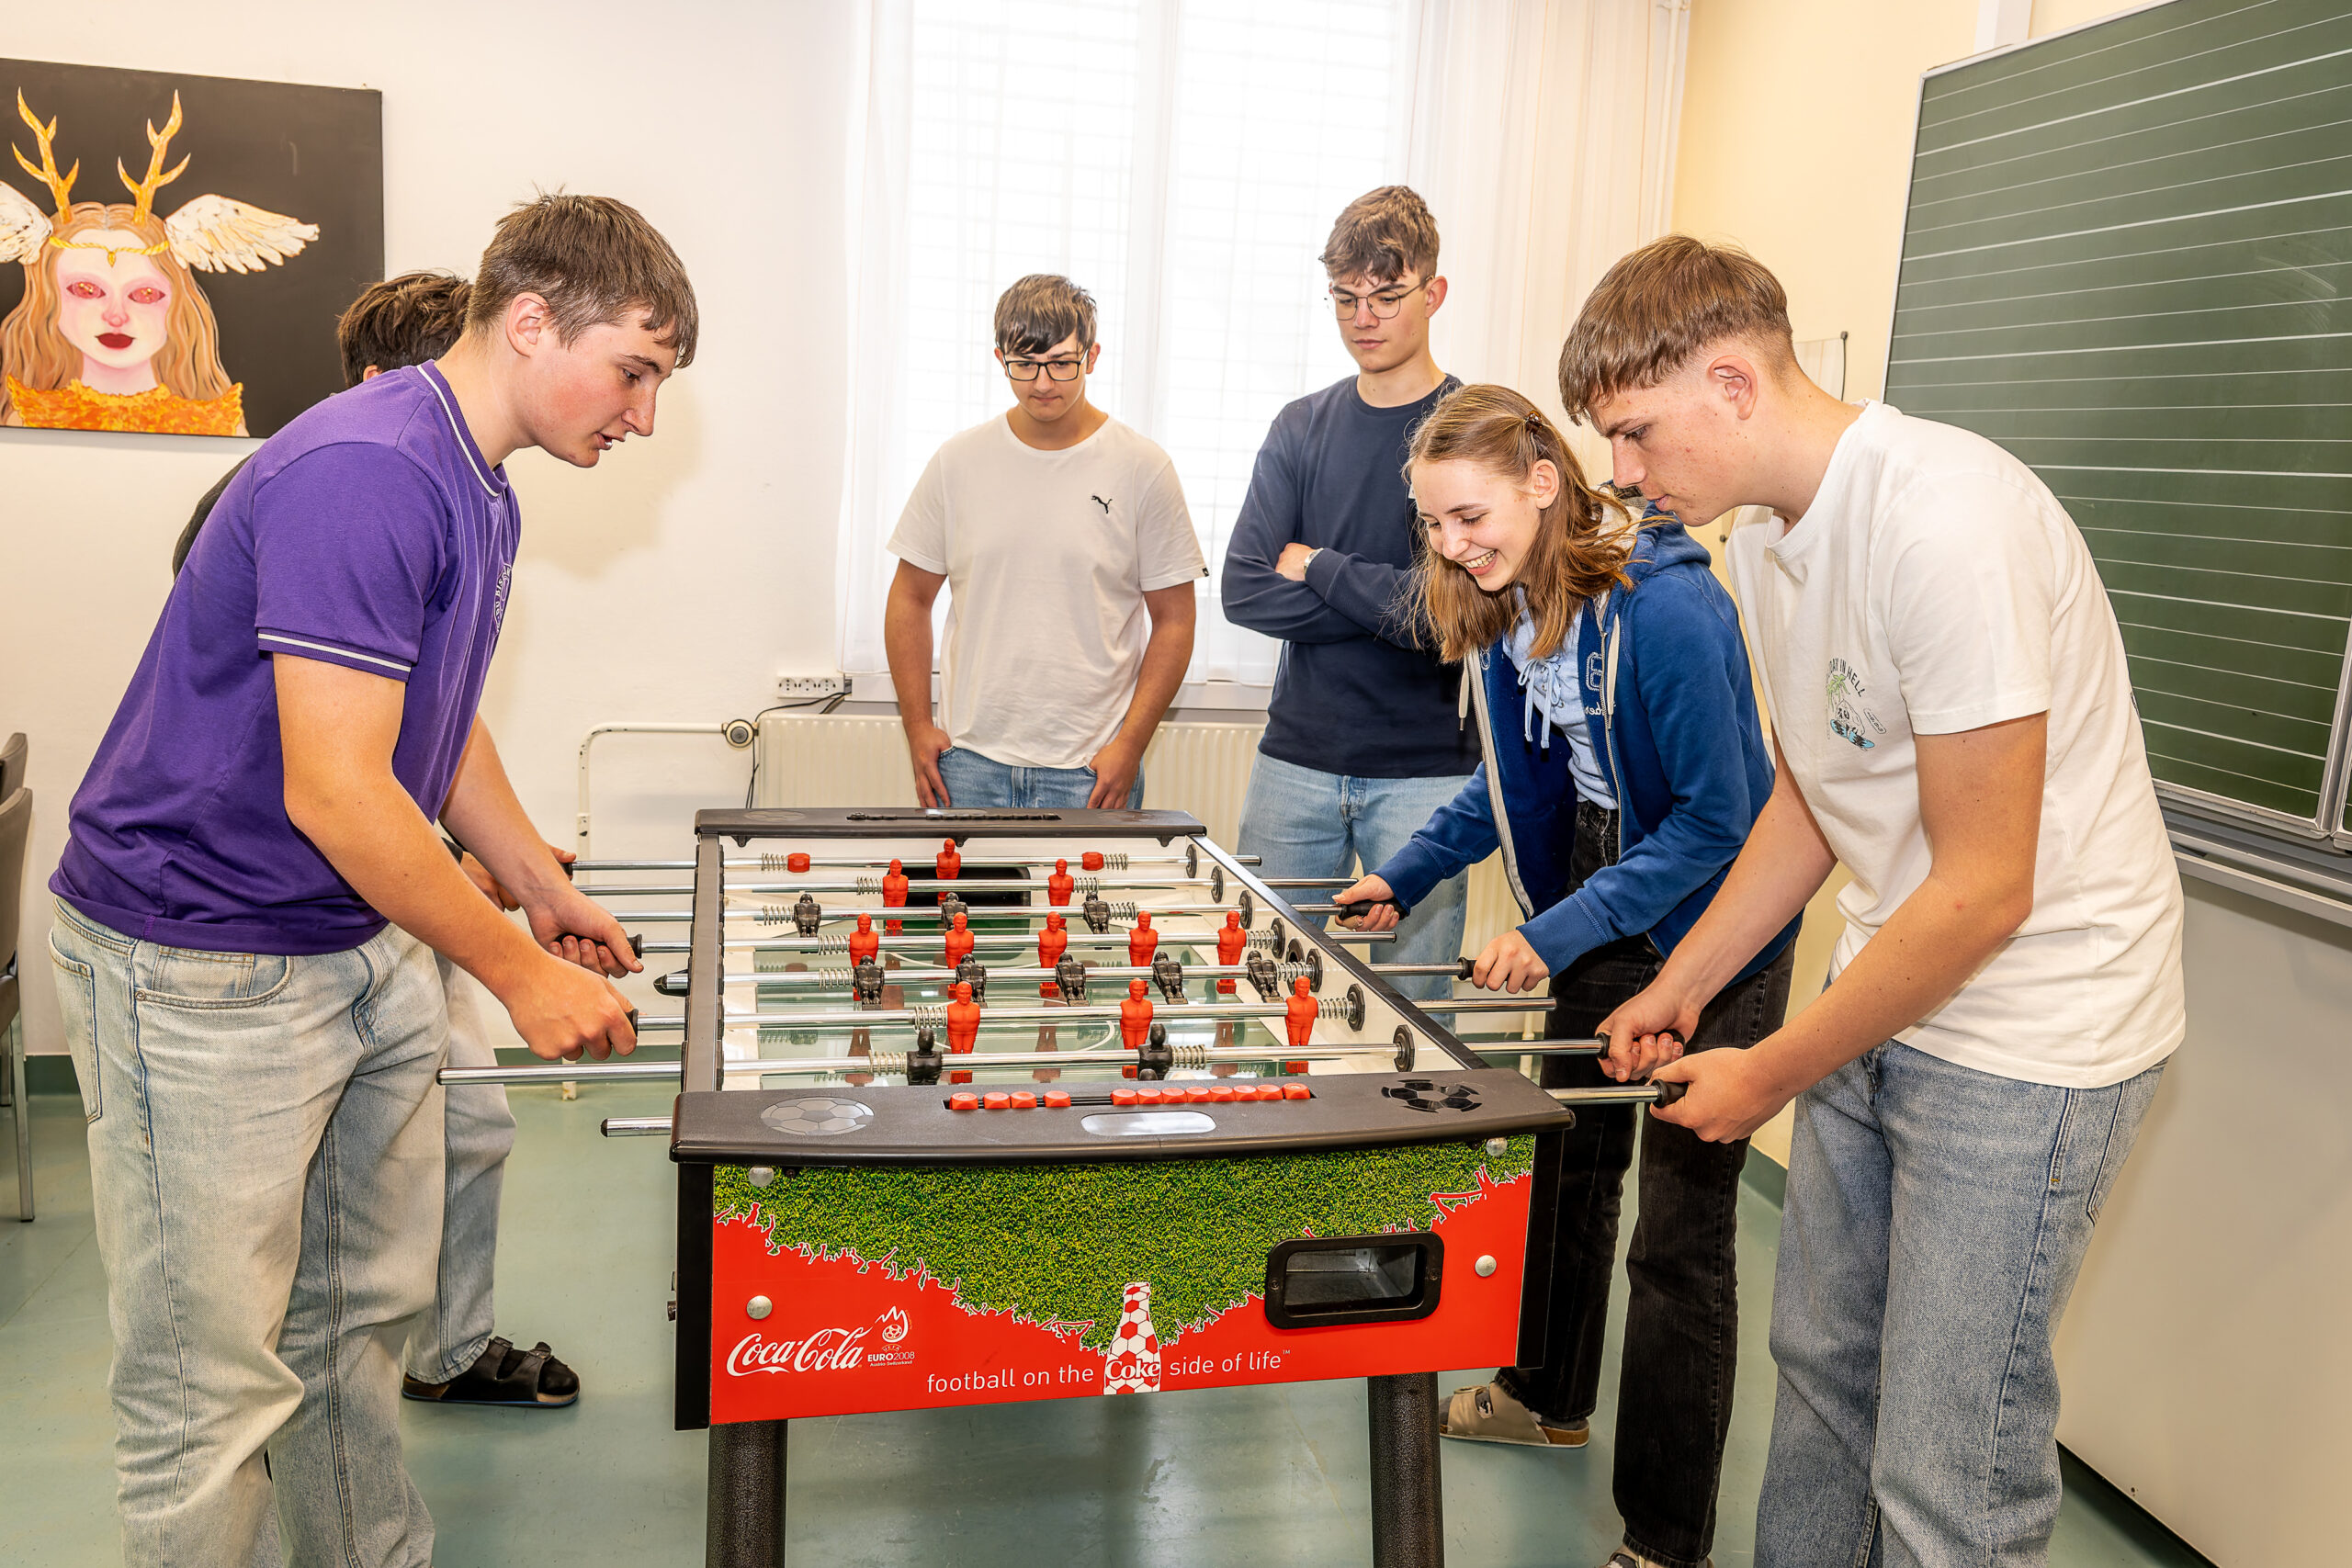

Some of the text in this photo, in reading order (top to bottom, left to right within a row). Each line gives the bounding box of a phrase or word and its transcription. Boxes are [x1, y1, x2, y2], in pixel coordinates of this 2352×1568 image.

[1847, 666, 1865, 697] HELL
[726, 1326, 865, 1376] Coca-Cola
[927, 1368, 1015, 1393] football
[1023, 1371, 1050, 1386] on
[1058, 1364, 1094, 1383] the
[1106, 1359, 1160, 1381] Coke
[1170, 1355, 1214, 1376] side
[1222, 1353, 1243, 1371] of
